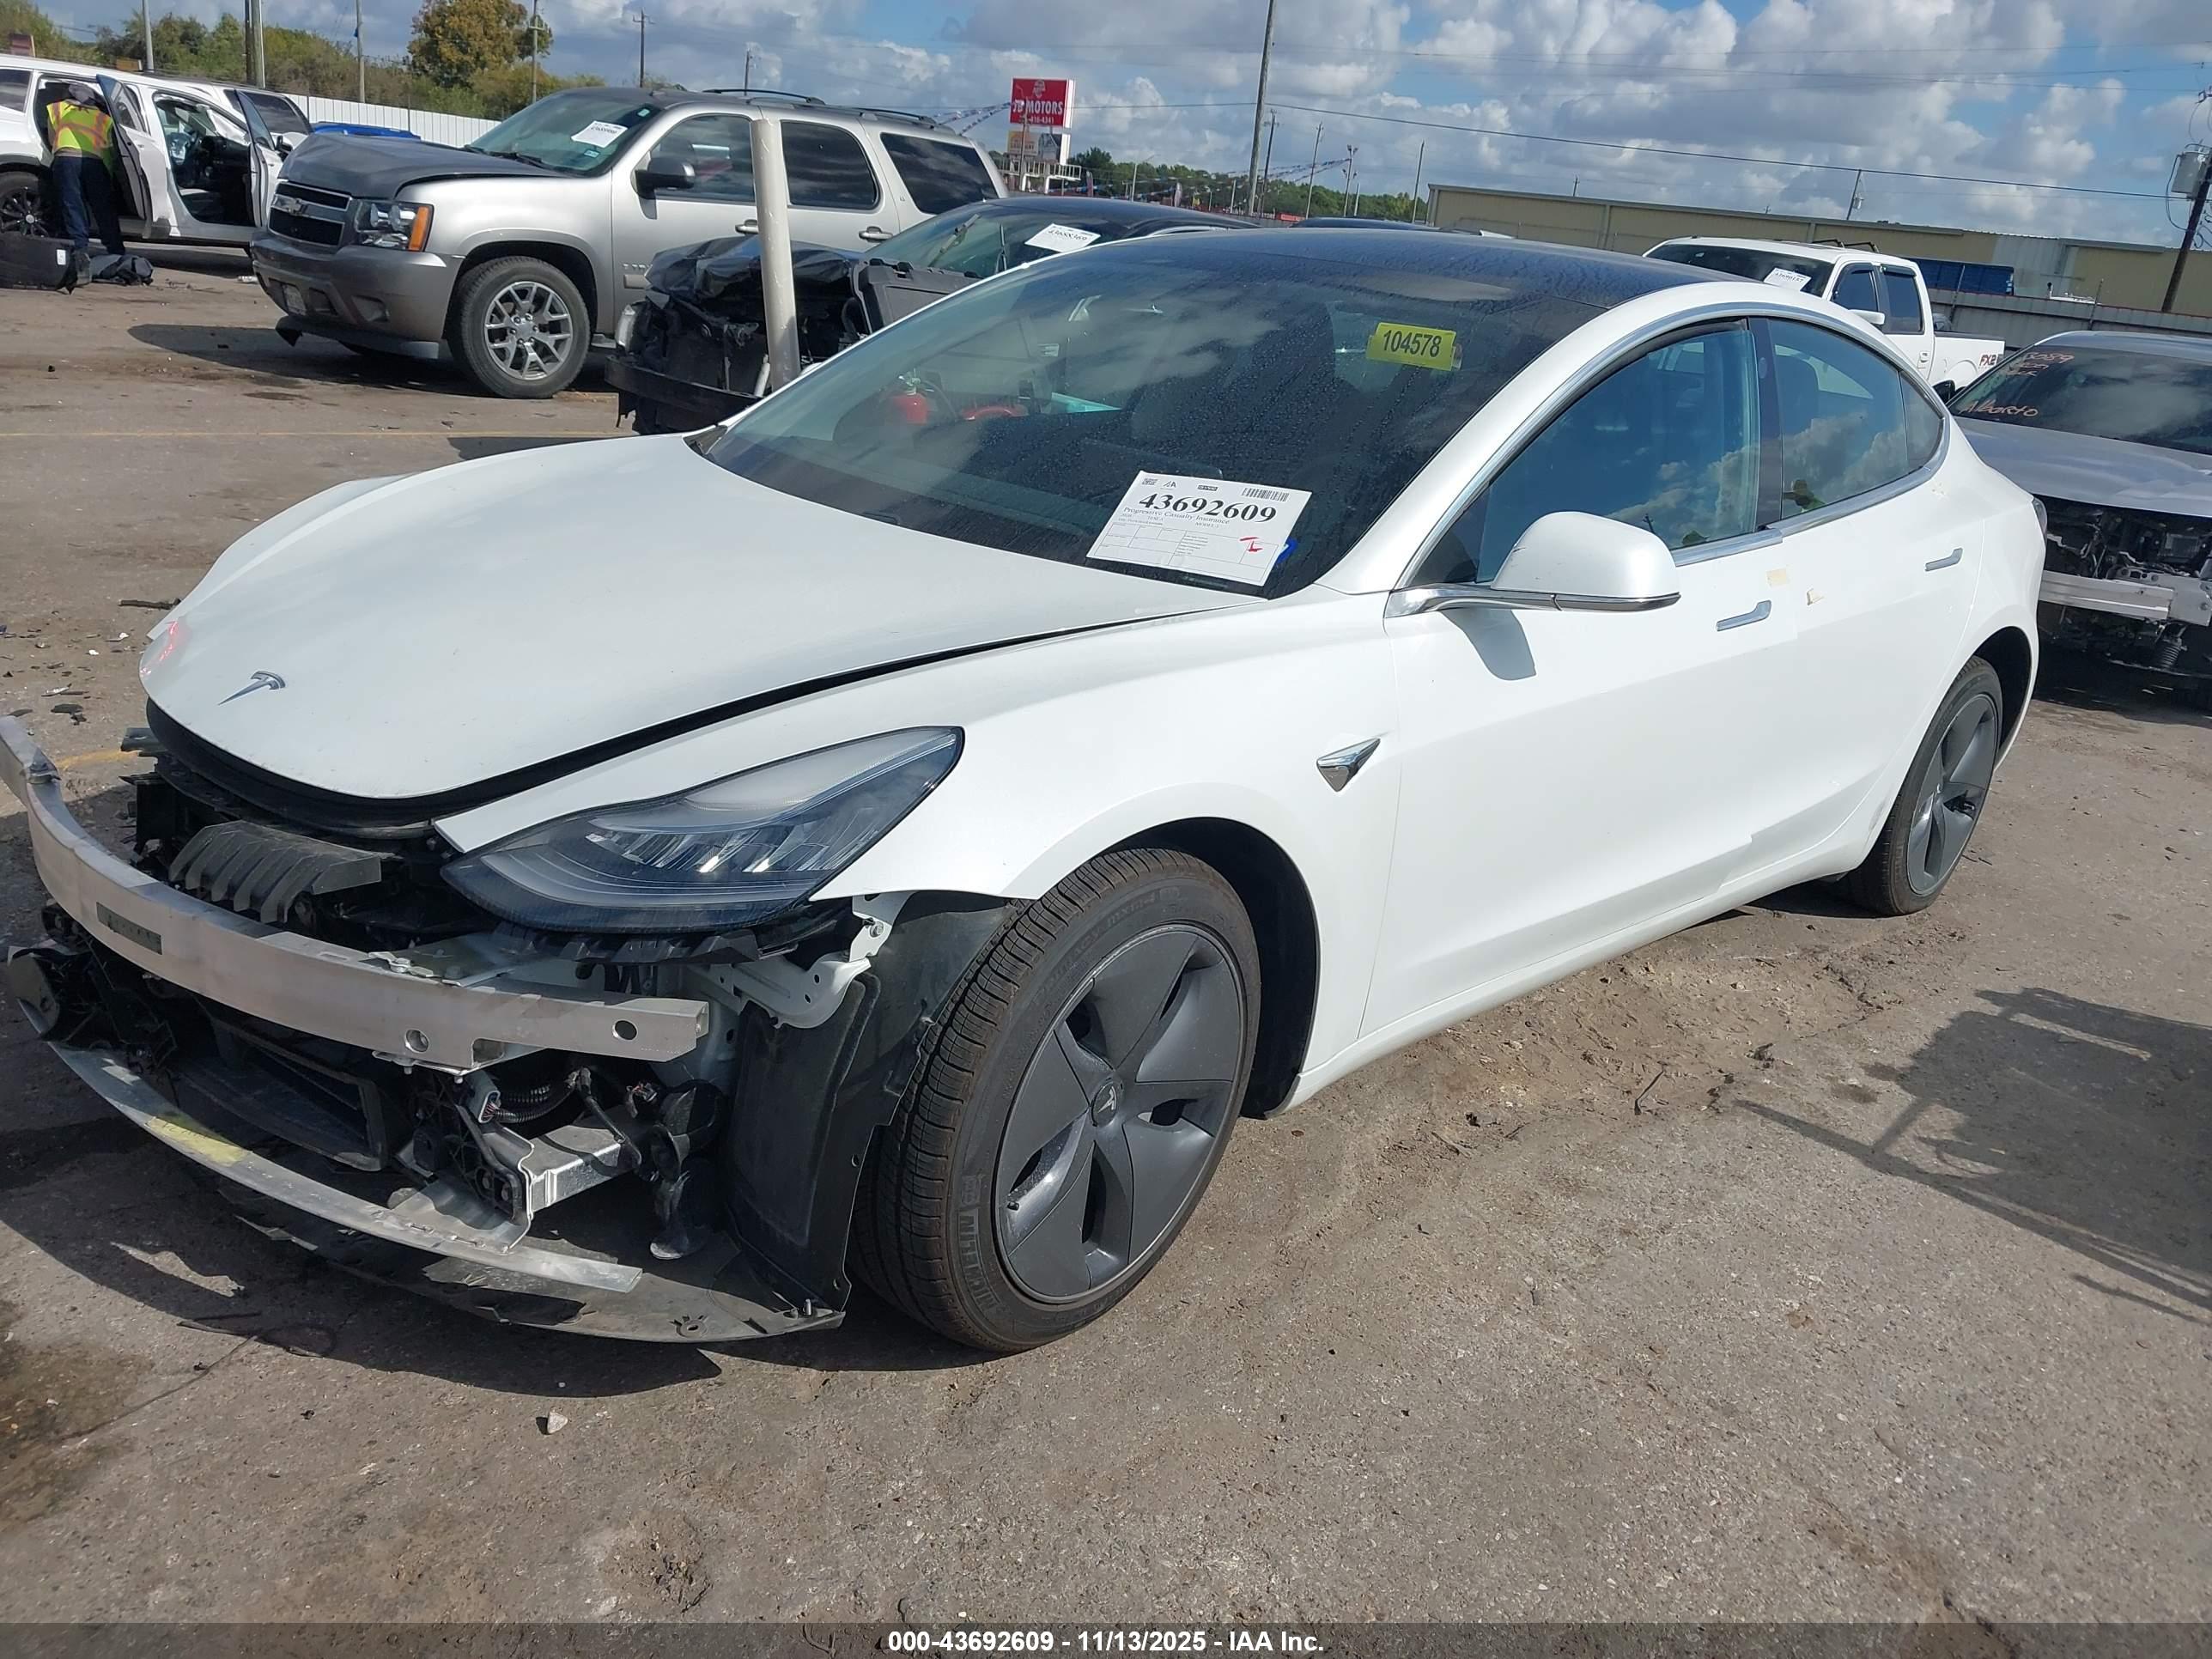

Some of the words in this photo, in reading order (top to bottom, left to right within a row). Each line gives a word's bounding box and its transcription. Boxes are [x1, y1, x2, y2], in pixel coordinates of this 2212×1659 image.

[1025, 99, 1064, 115] MOTORS
[1383, 330, 1443, 357] 104578
[1978, 354, 1997, 367] FX2
[1123, 507, 1164, 517] Progressive
[1164, 511, 1193, 520] Casualty
[1195, 514, 1231, 525] Insurance
[1139, 492, 1278, 524] 43692609
